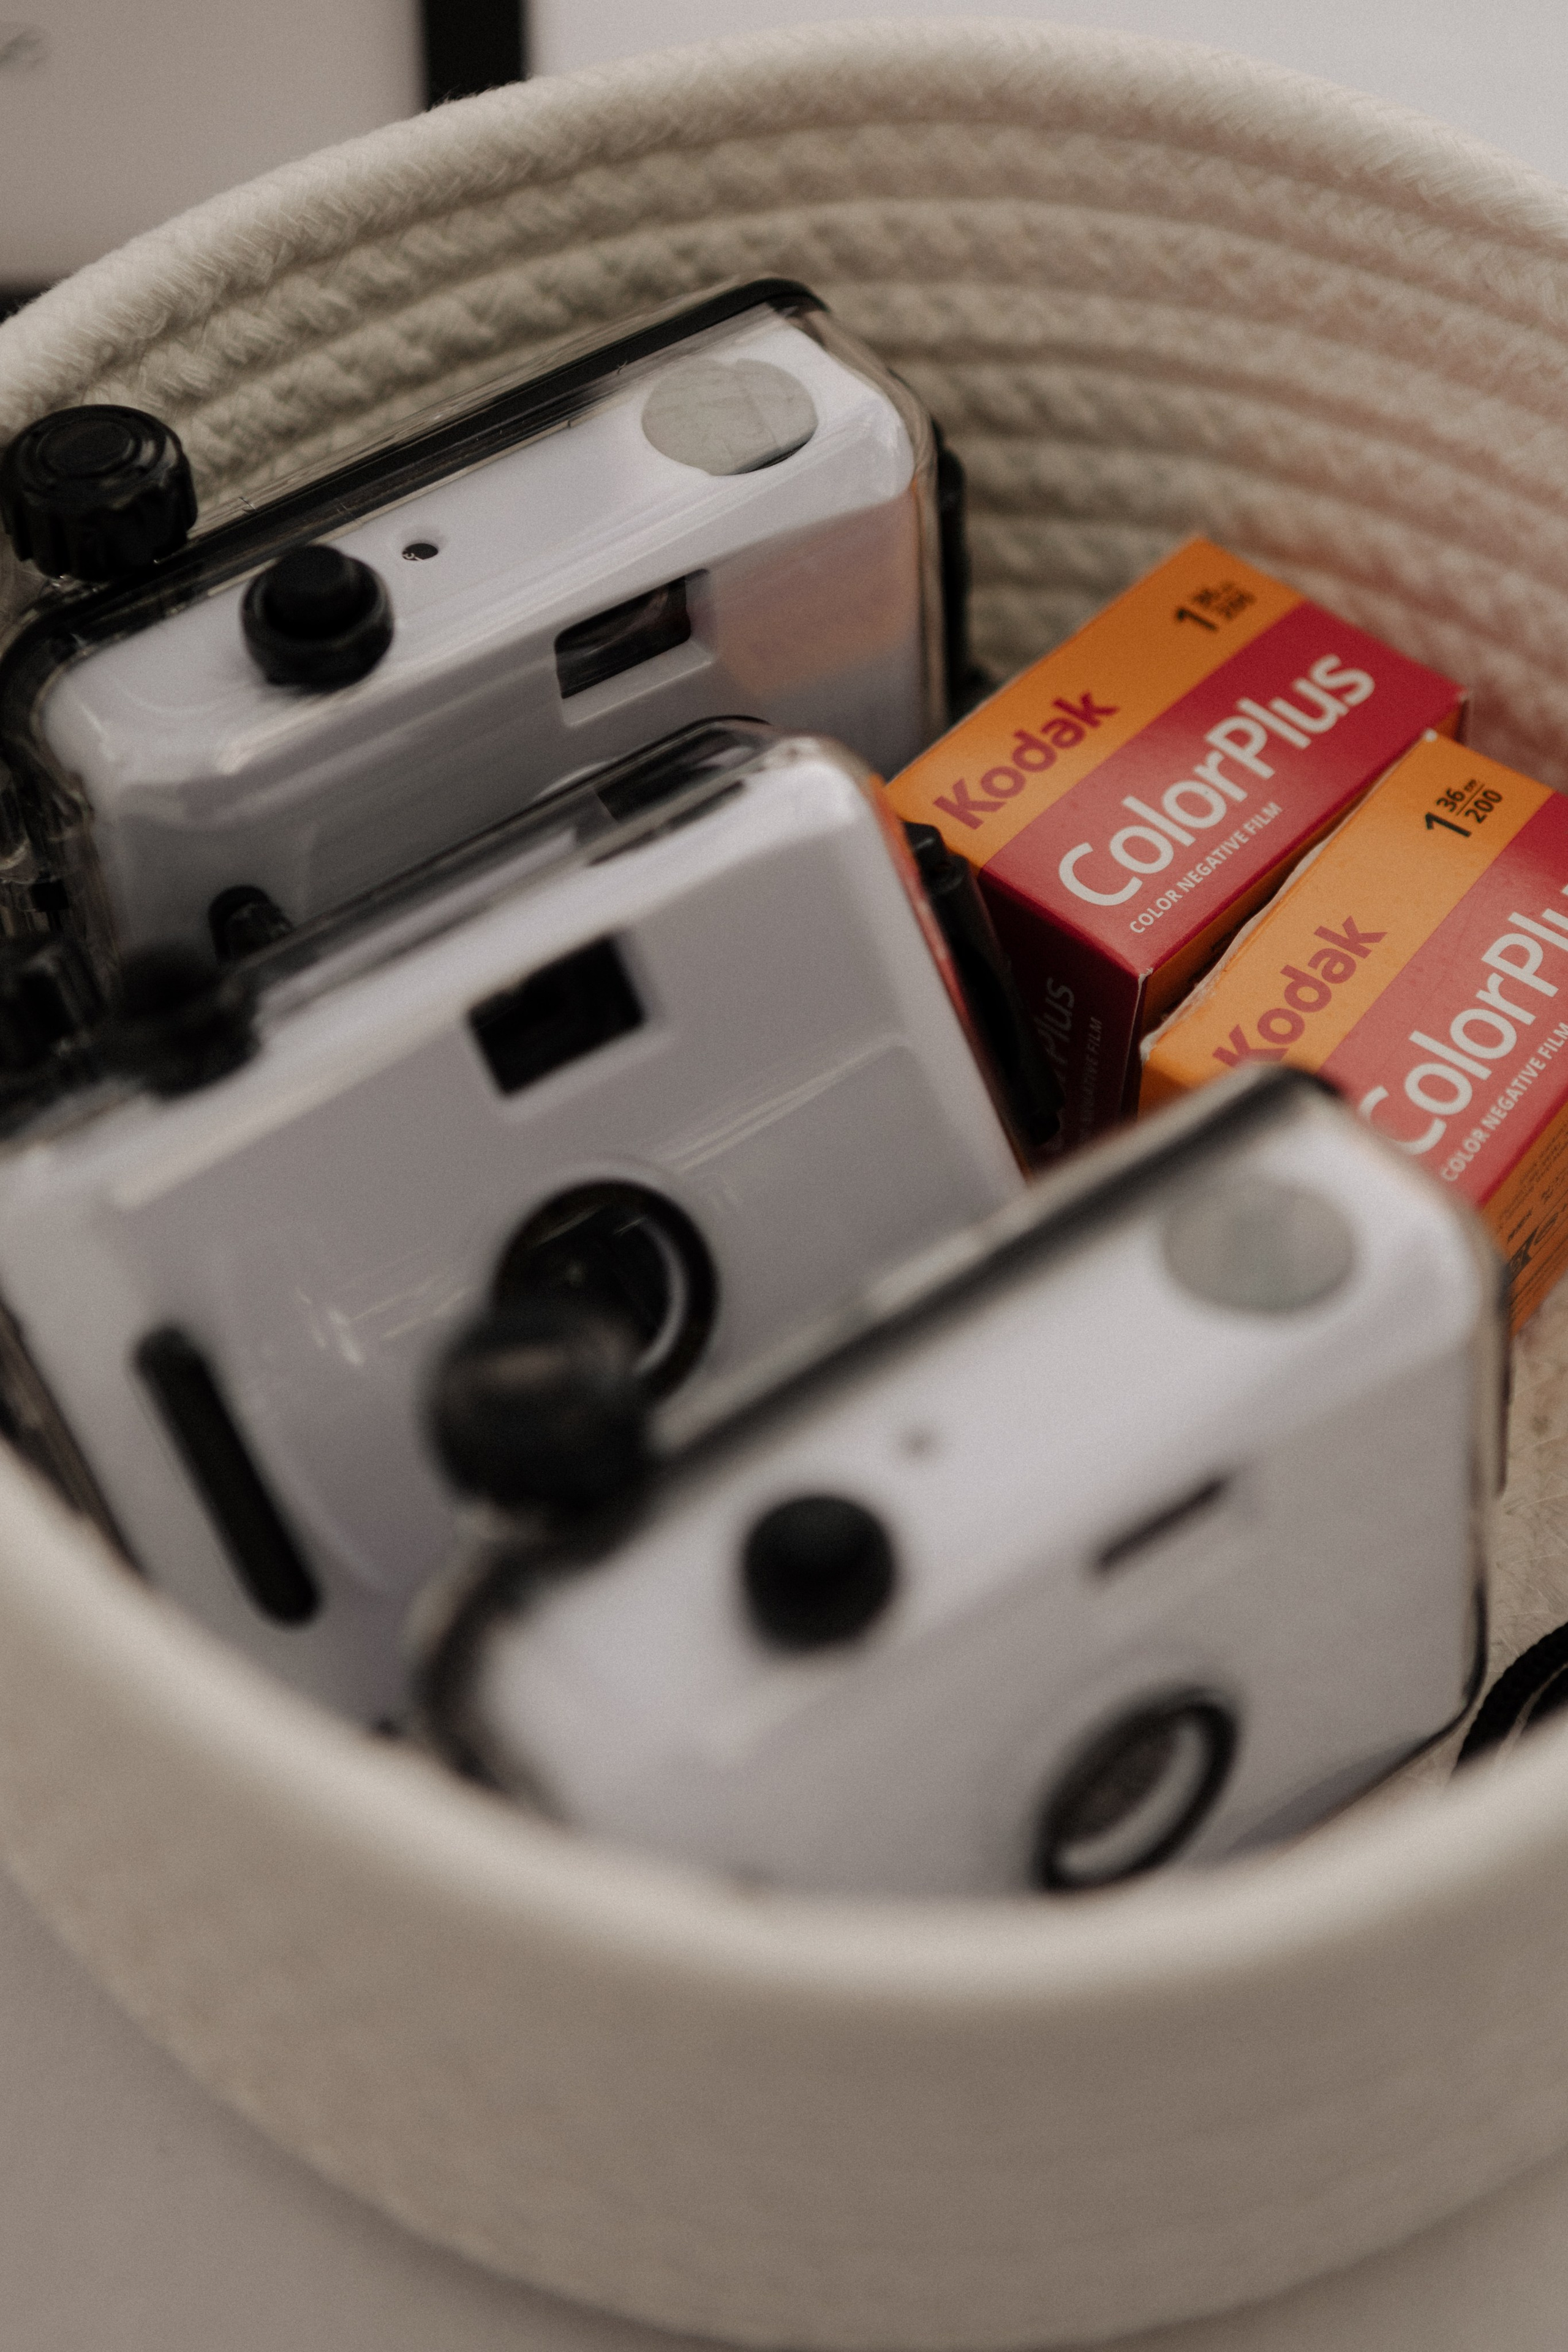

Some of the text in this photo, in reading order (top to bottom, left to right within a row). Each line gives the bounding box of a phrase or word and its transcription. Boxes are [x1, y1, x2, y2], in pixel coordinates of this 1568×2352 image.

[1177, 606, 1218, 631] 1
[933, 692, 1120, 830] Kodak
[1058, 654, 1376, 907] ColorPlus
[1425, 787, 1472, 838] 1 36
[1464, 790, 1502, 824] 200
[1129, 801, 1283, 933] COLOR NEGATIVE FILM
[1212, 915, 1389, 1068] Kodak
[1441, 1128, 1491, 1182] COLOR
[1480, 1056, 1547, 1131] NEGATIVE
